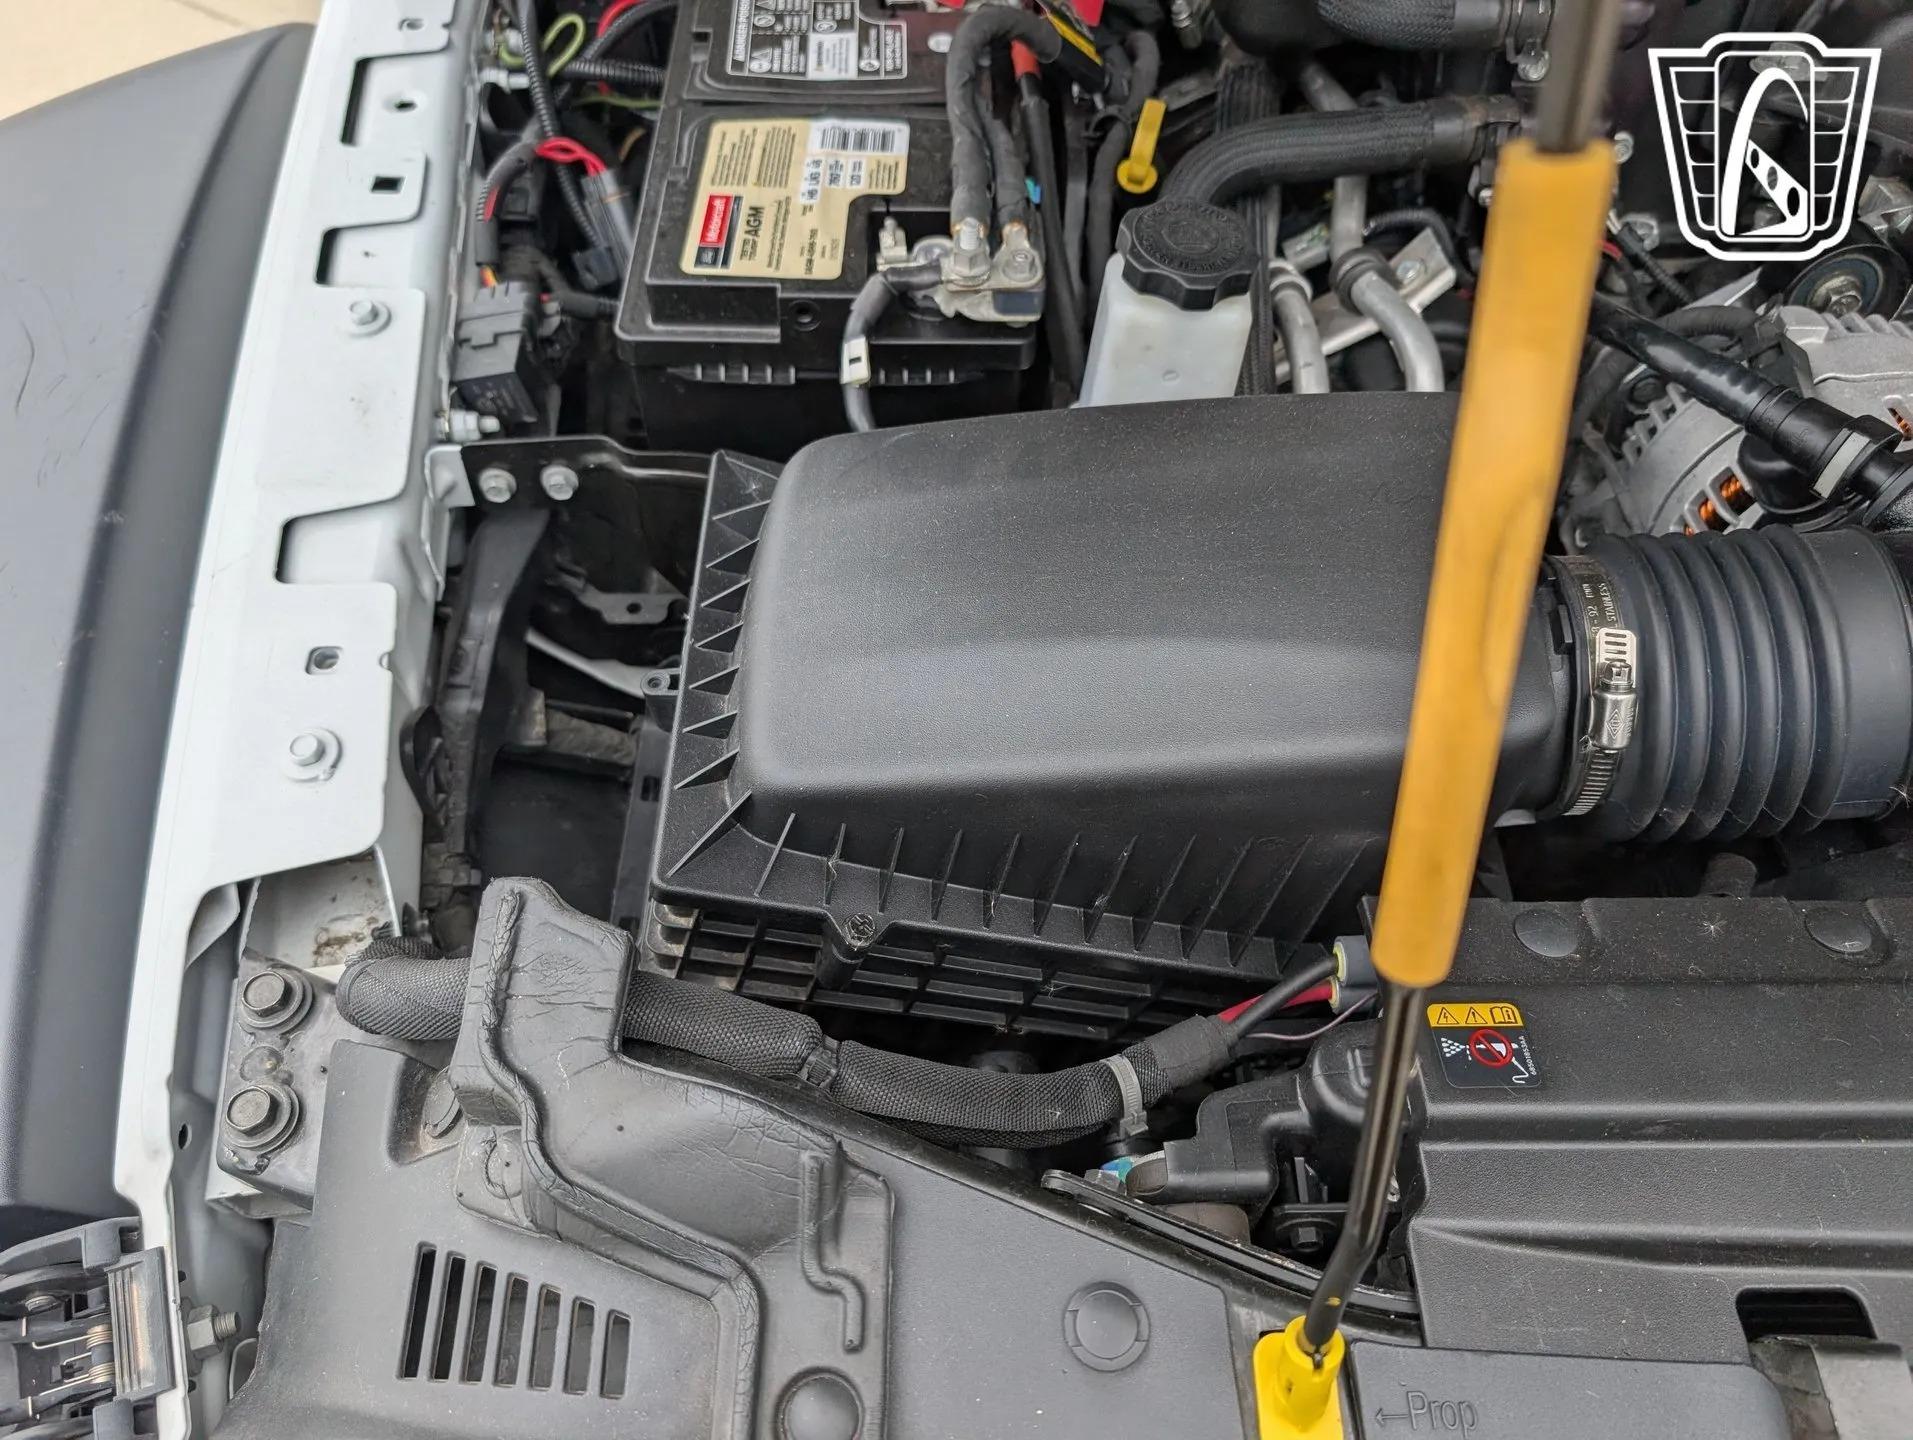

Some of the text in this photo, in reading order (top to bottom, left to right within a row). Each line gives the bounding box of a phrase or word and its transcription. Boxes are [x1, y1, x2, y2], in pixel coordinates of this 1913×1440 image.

[708, 199, 726, 243] Motorcraft
[744, 206, 765, 237] AGM
[1586, 605, 1599, 617] 92
[1597, 583, 1617, 622] STAINLESS
[1405, 1390, 1479, 1440] Prop
